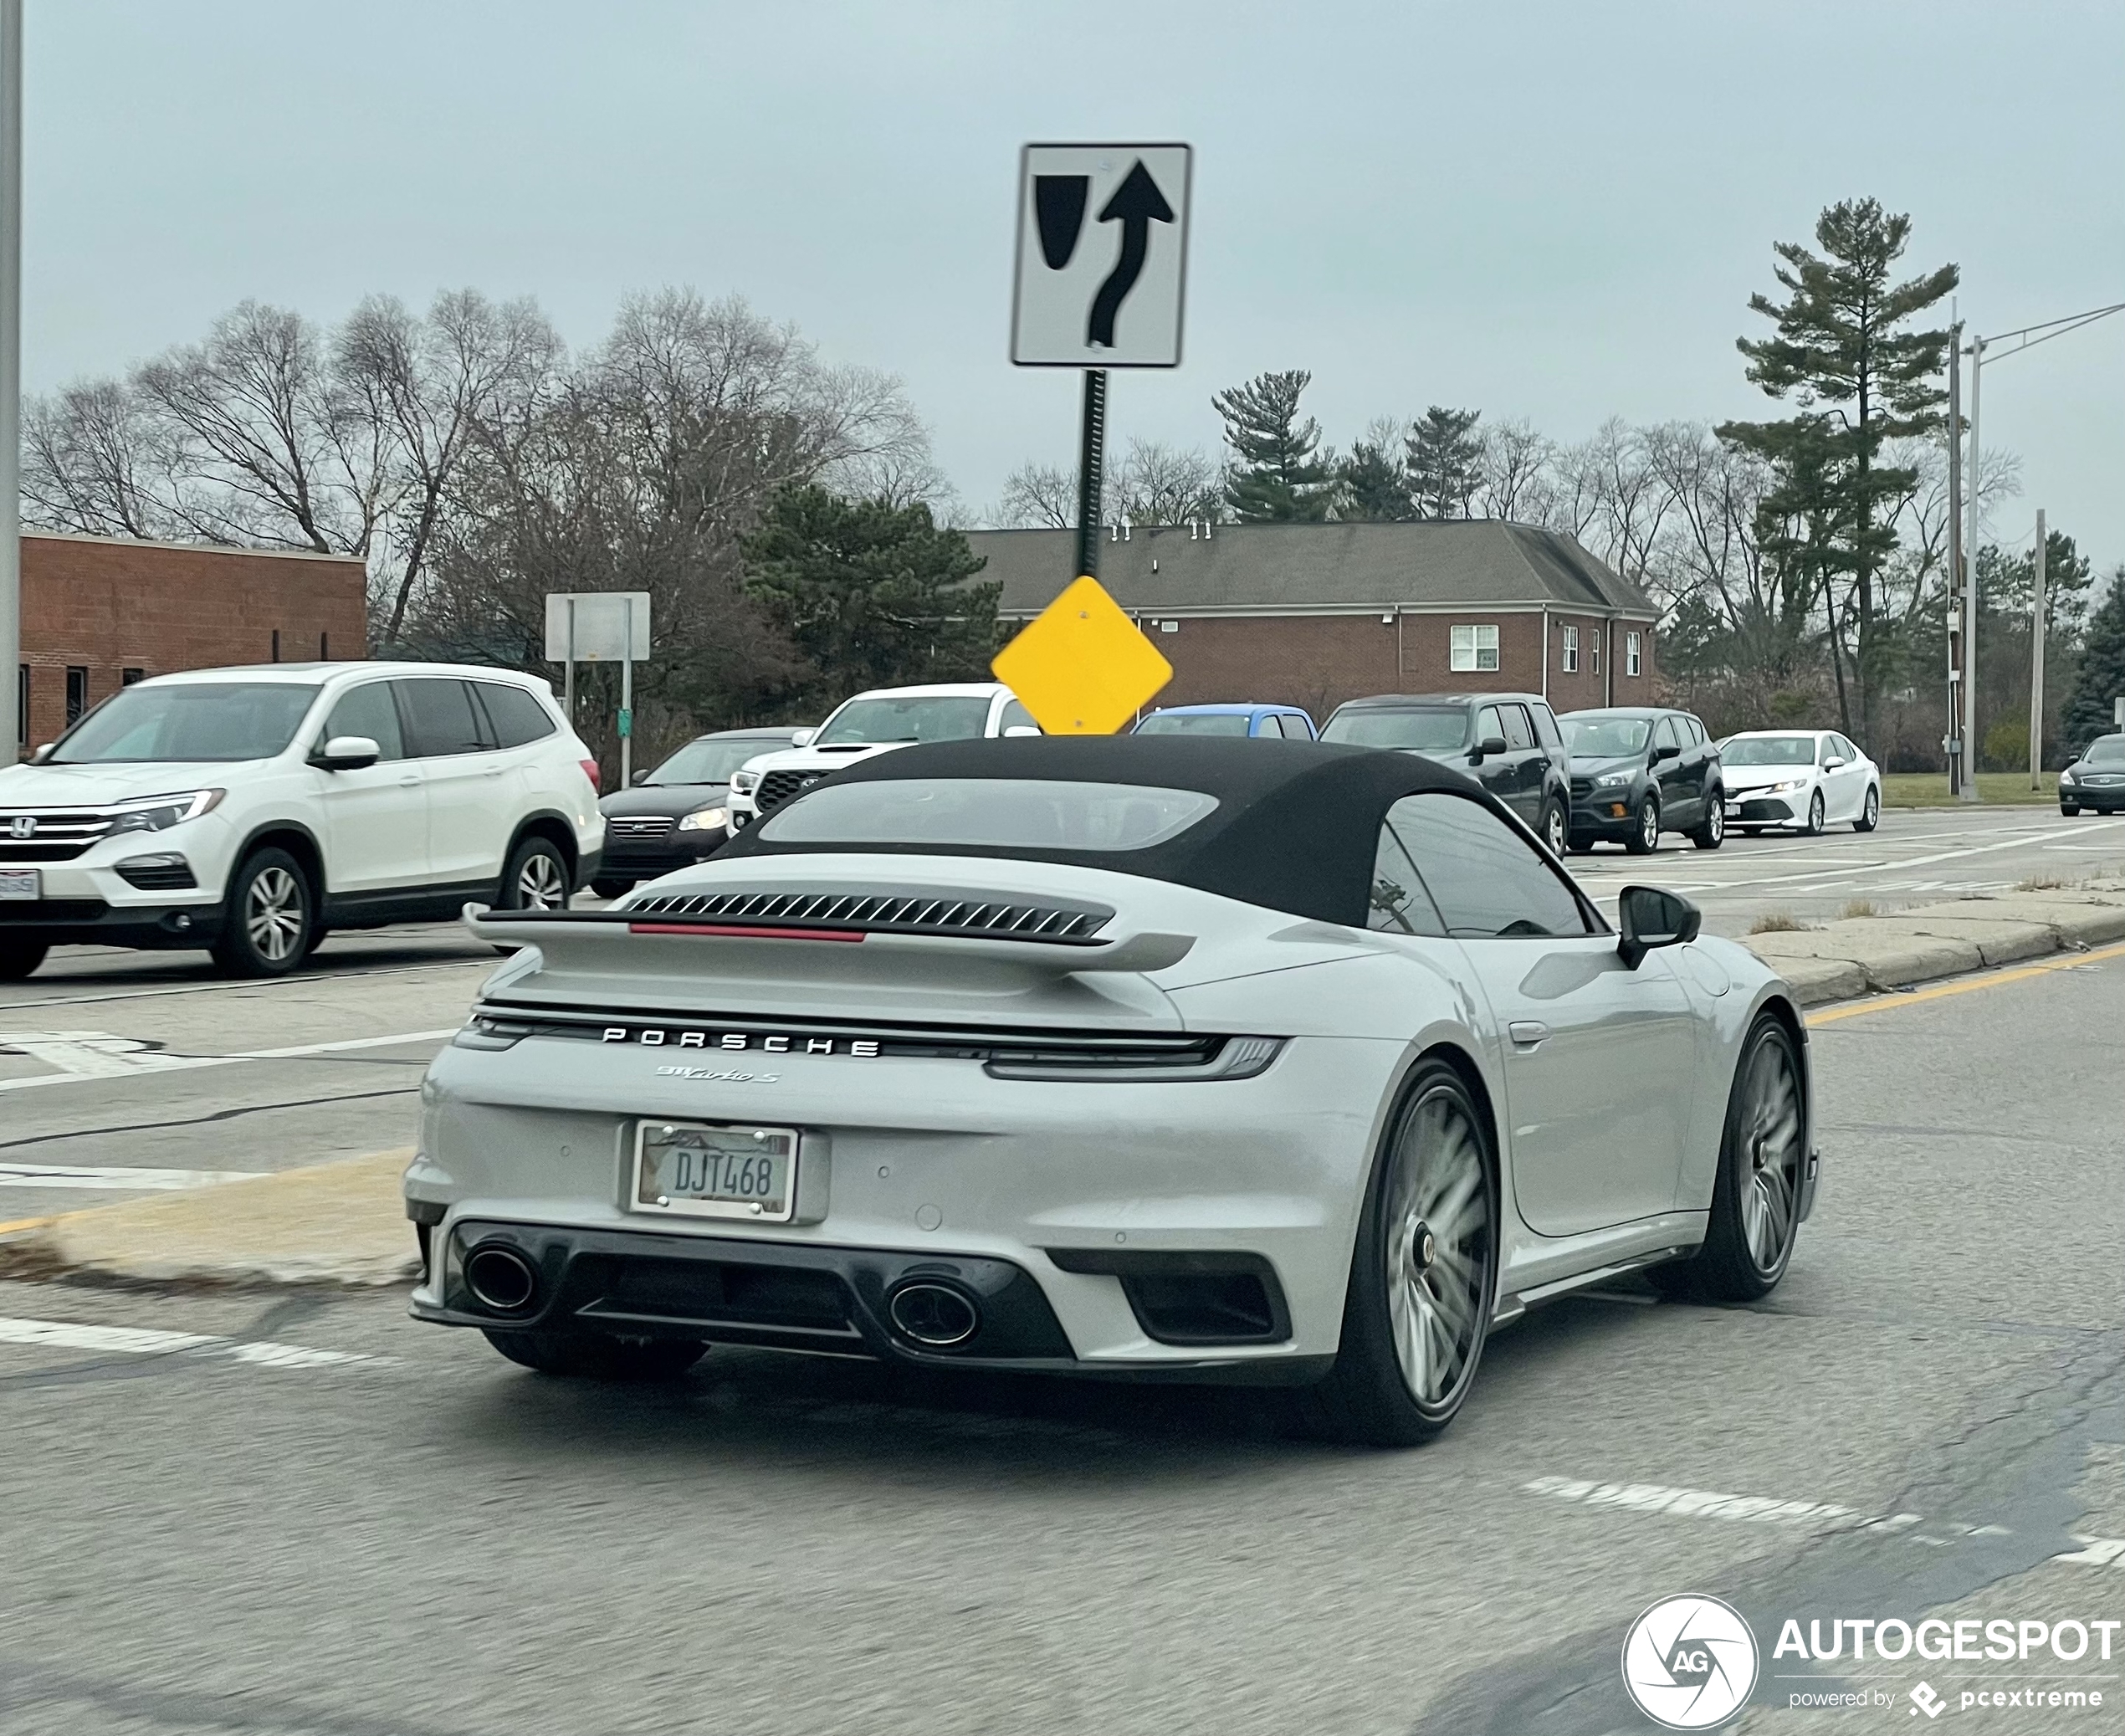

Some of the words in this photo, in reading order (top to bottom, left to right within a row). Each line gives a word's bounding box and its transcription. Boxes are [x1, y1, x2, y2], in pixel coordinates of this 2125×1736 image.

[602, 1028, 879, 1057] PORSCHE
[684, 1068, 755, 1082] Turbo
[751, 1073, 782, 1083] S
[674, 1152, 773, 1196] DJT468
